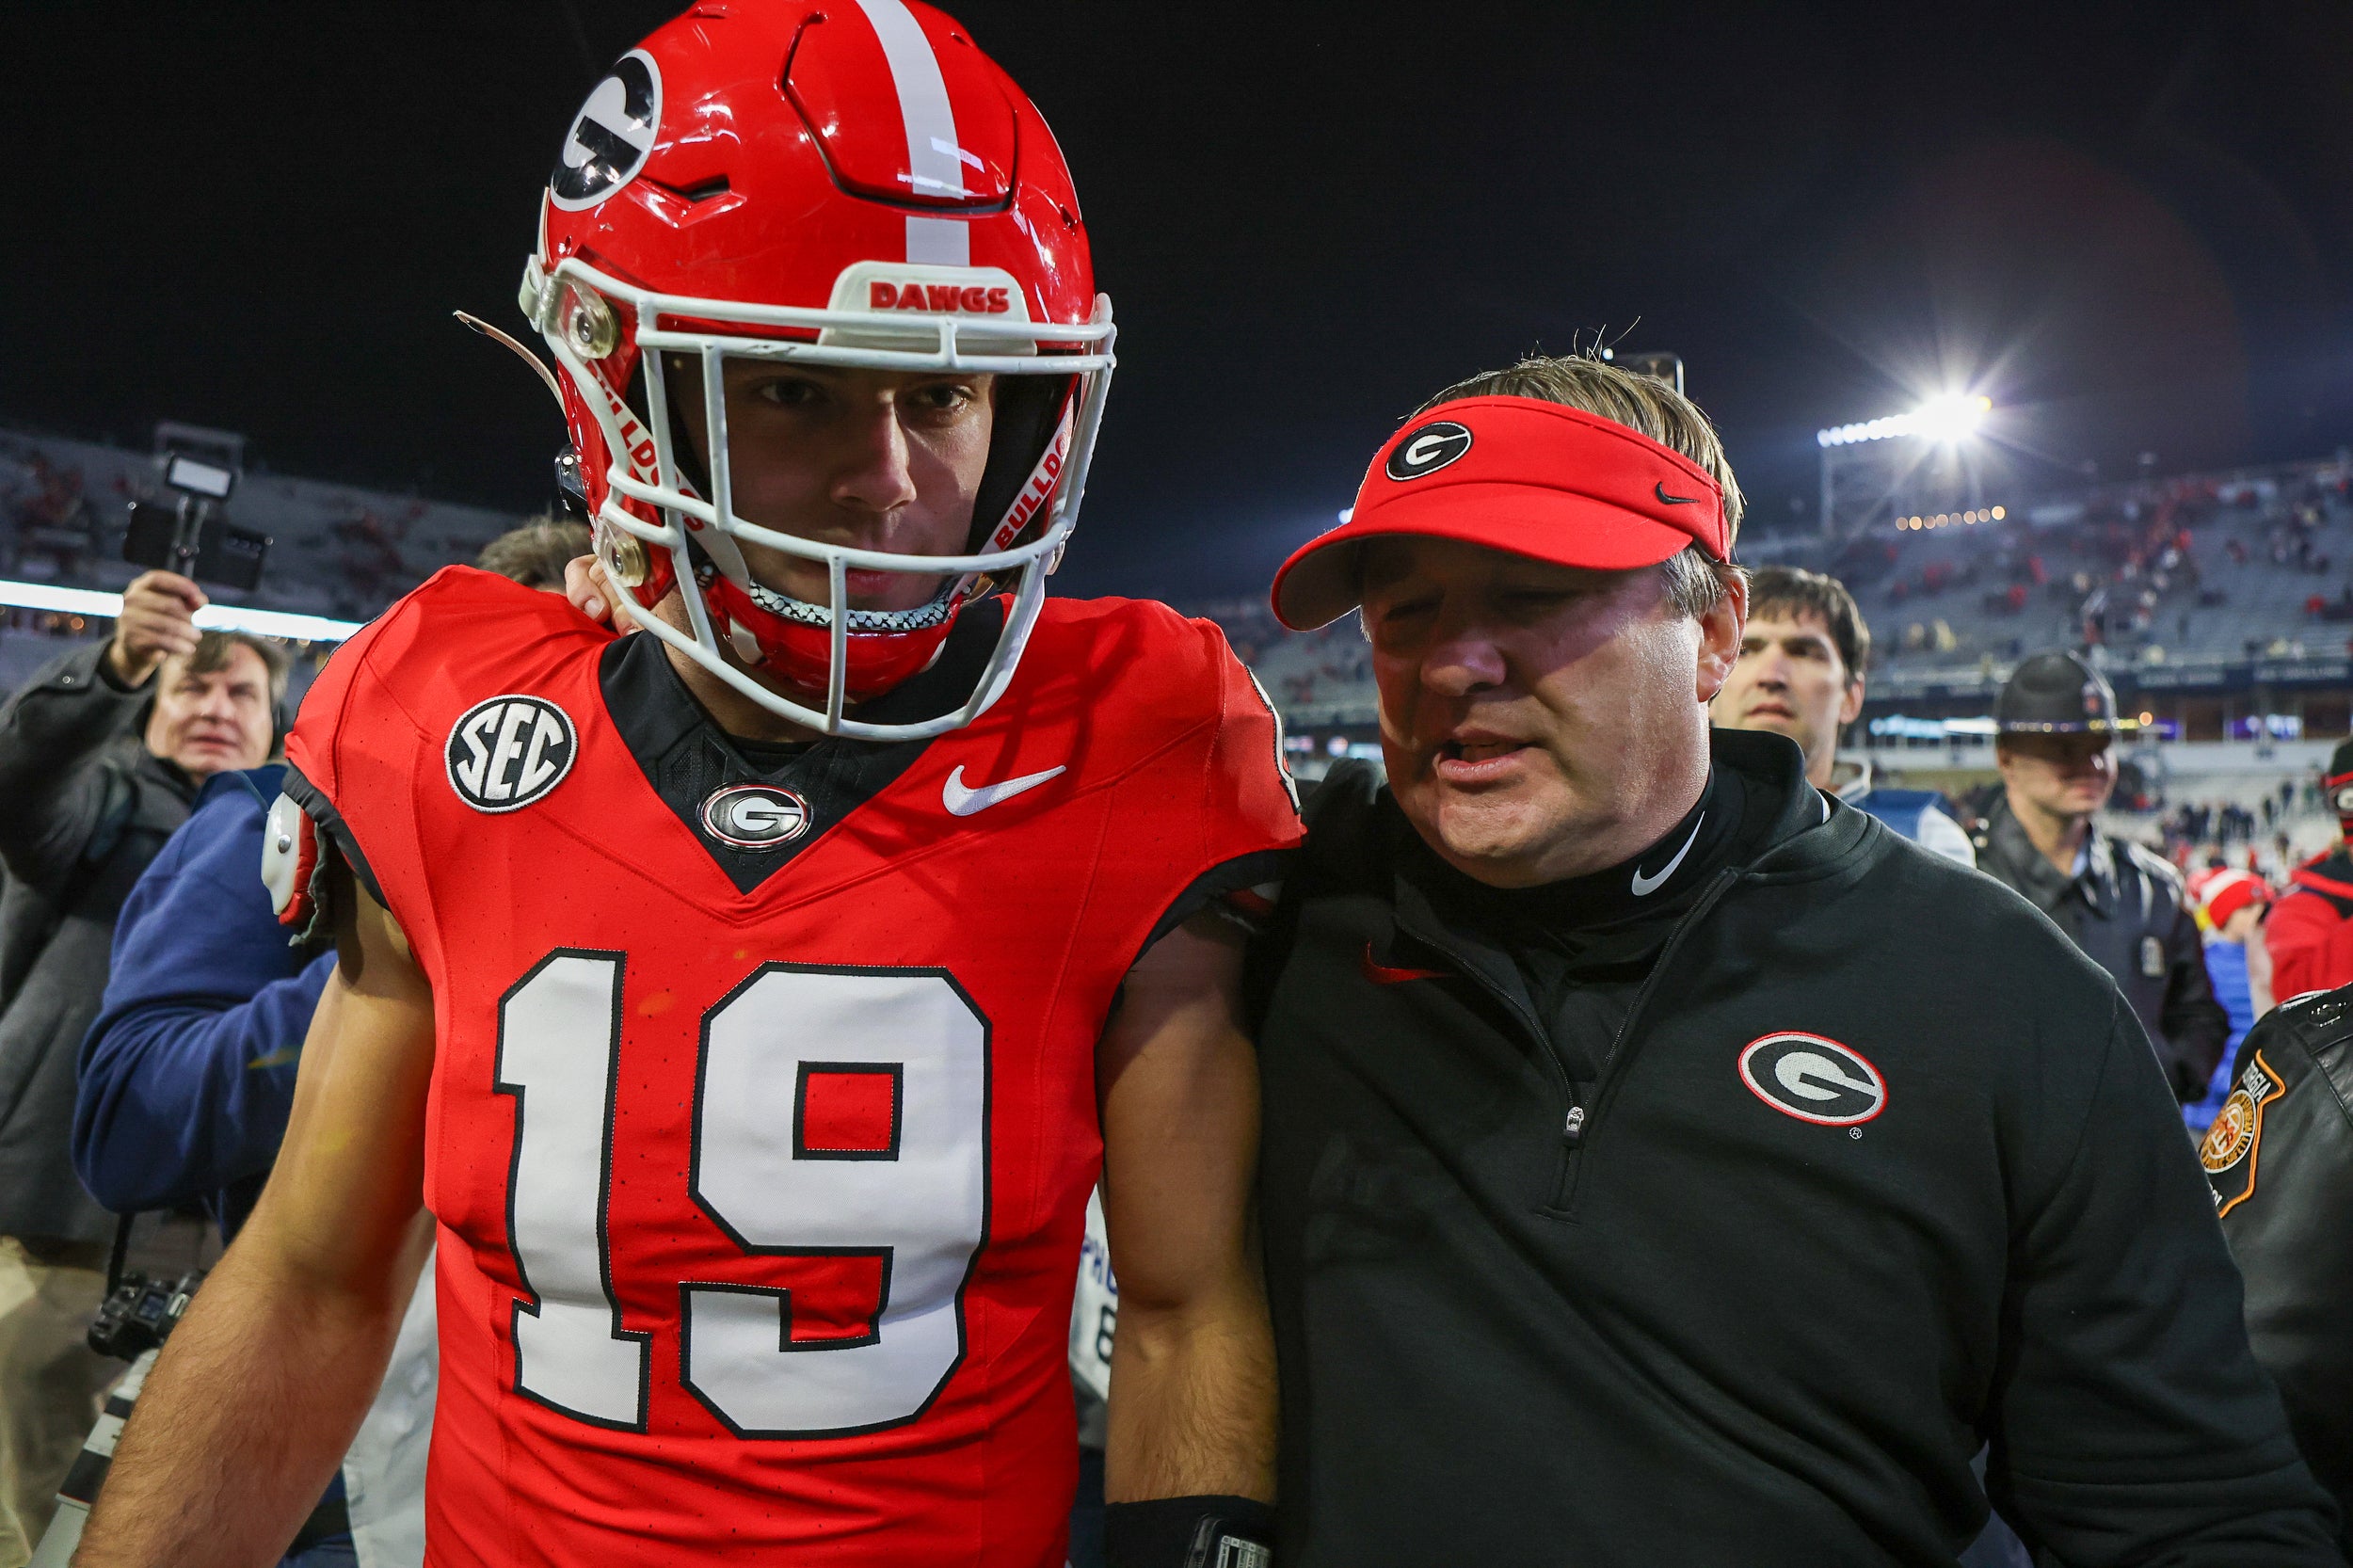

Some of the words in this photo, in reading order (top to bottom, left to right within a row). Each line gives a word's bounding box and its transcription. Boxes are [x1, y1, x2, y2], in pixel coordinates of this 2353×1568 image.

[552, 54, 657, 202] G
[870, 281, 1010, 313] DAWGS
[993, 424, 1071, 552] BULLDO
[1385, 421, 1473, 481] G
[456, 702, 565, 801] SEC
[706, 787, 806, 844] G
[1743, 1035, 1883, 1122] G
[492, 945, 993, 1441] 19
